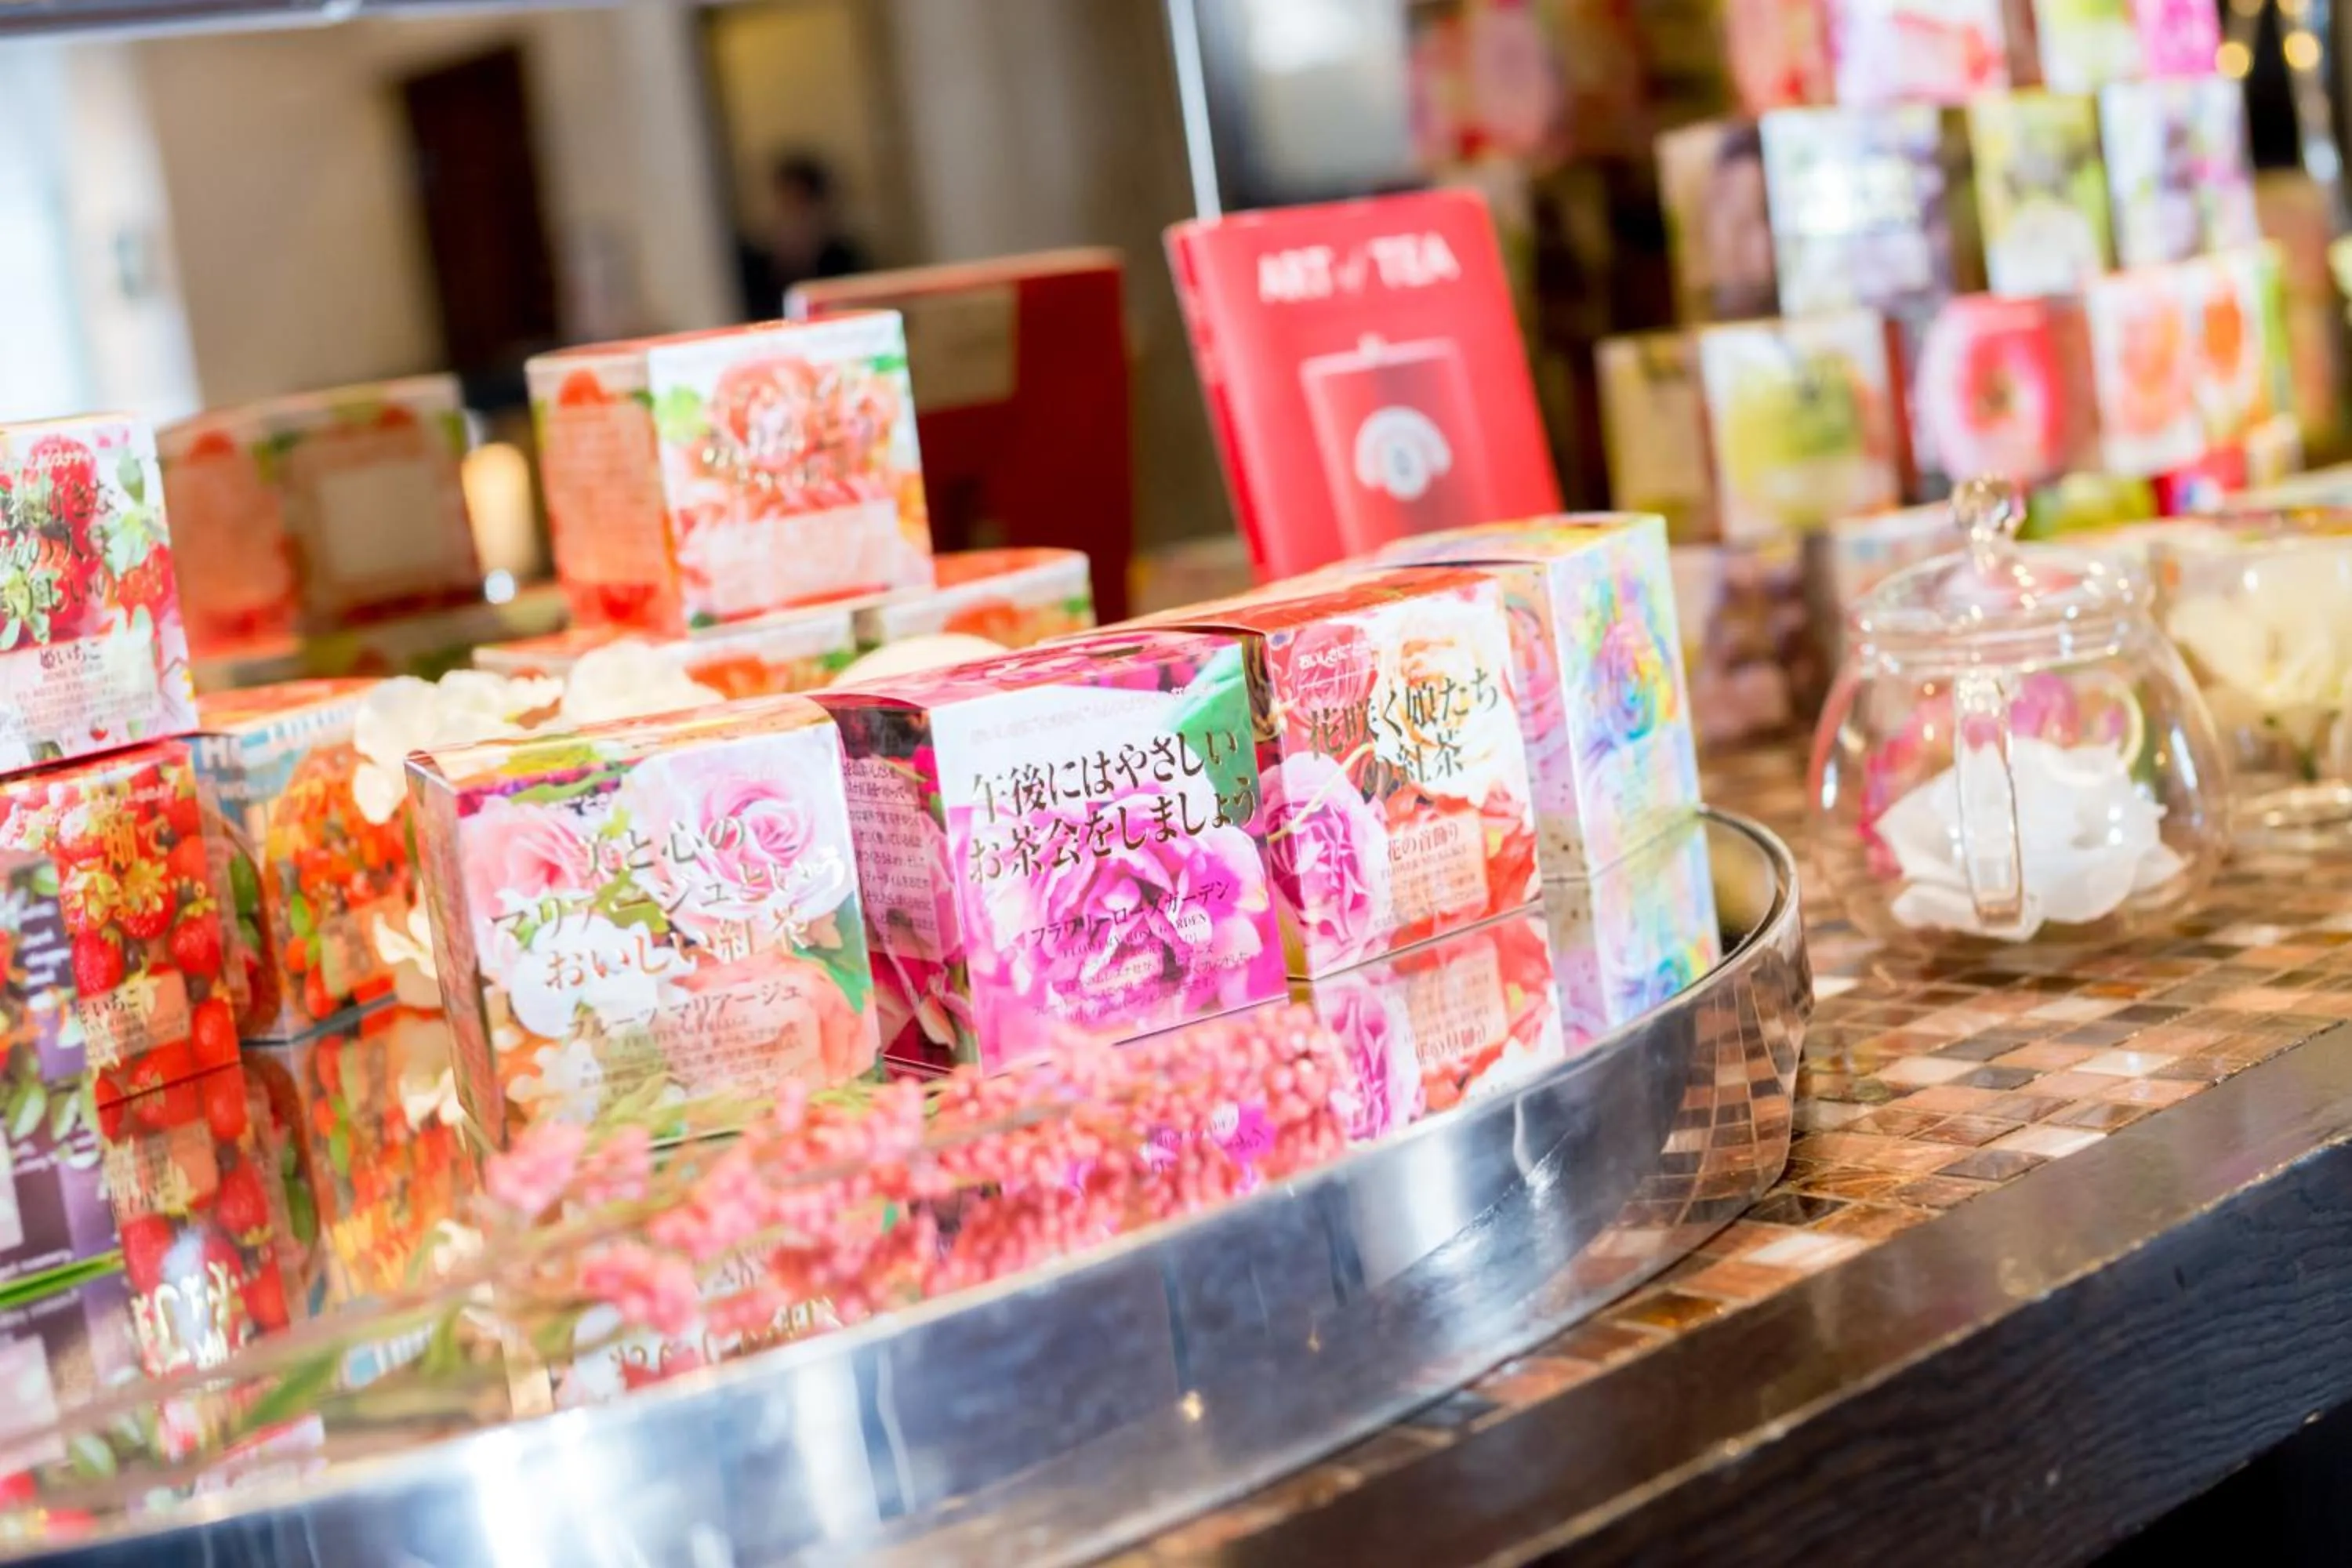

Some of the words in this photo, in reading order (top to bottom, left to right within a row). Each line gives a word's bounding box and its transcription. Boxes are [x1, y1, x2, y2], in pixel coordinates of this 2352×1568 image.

[971, 728, 1239, 823] 午後にはやさしい
[970, 776, 1256, 884] お茶会をしましょう
